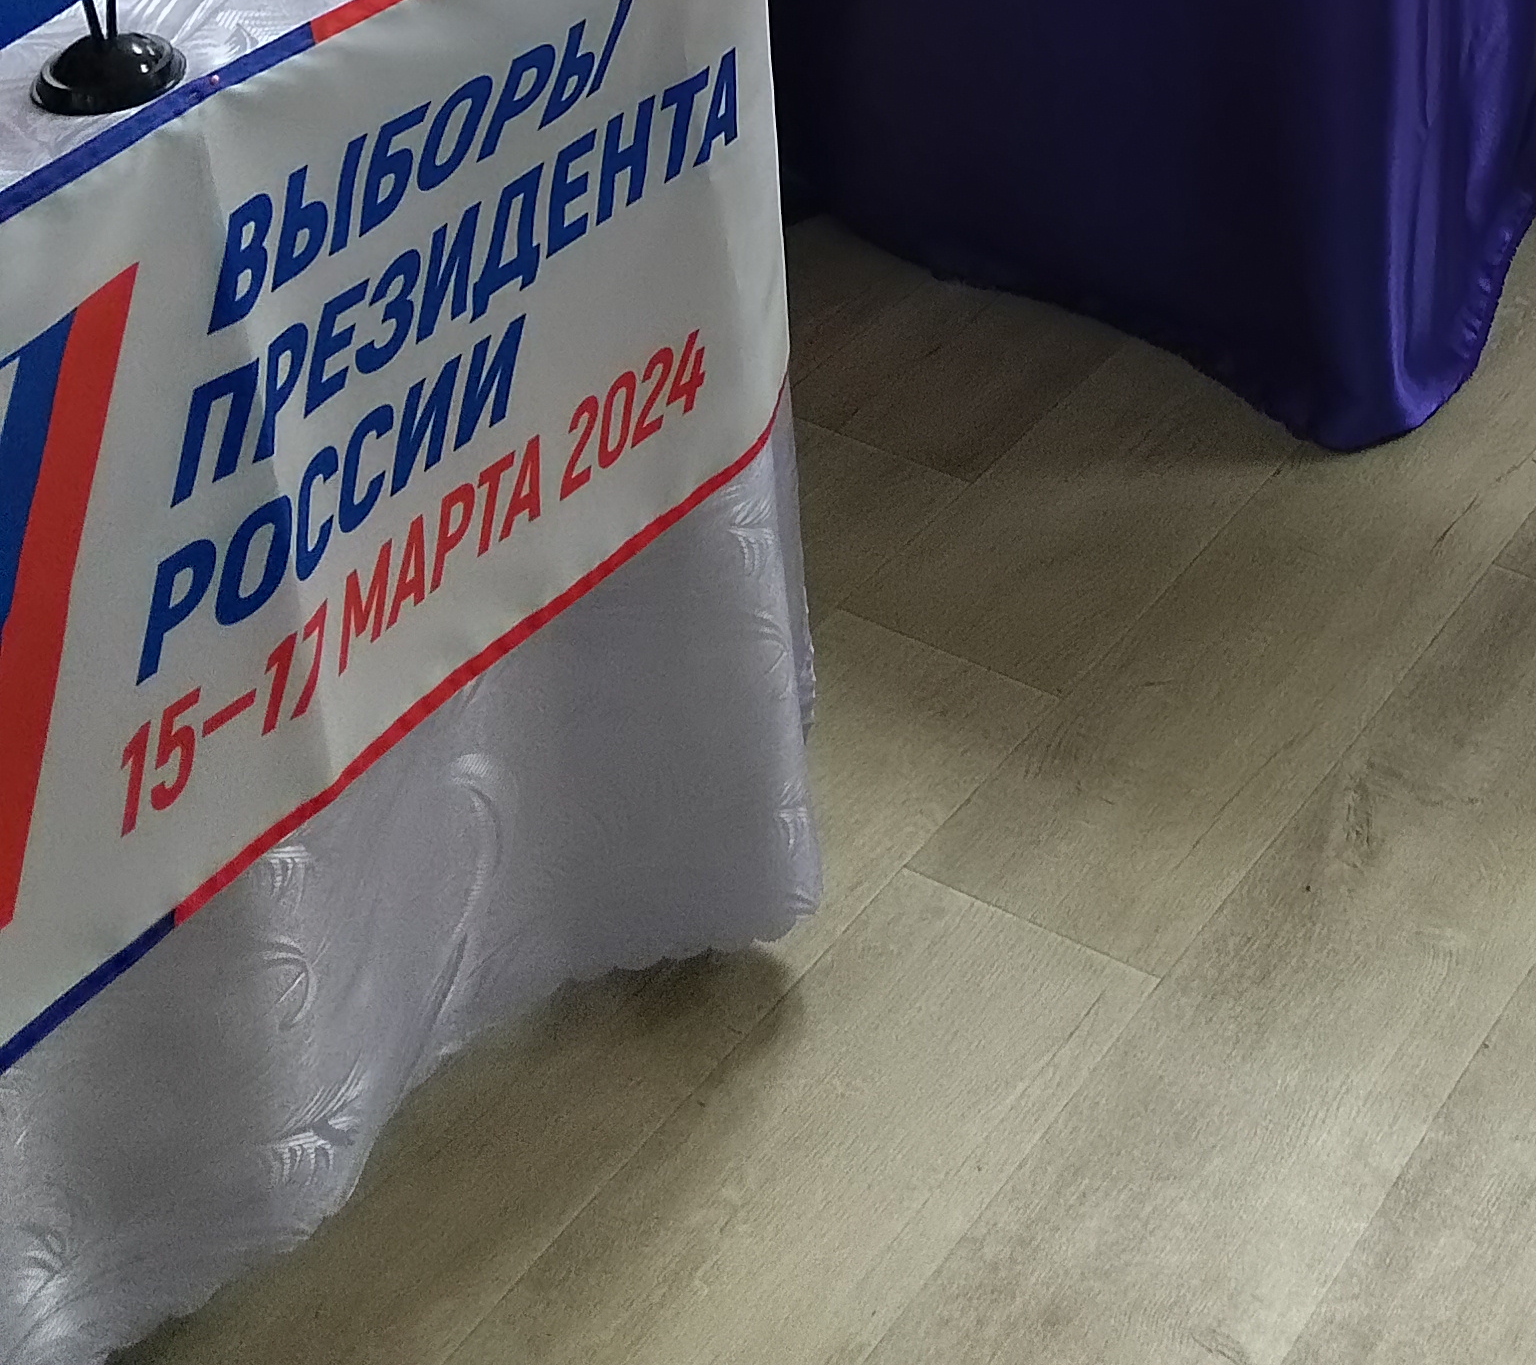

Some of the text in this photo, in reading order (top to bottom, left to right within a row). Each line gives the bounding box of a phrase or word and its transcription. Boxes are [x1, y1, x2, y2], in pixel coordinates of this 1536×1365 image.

[172, 50, 738, 505] ПРЕЗИДЕНТА
[137, 314, 525, 686] РОССИИ
[339, 437, 540, 672] МАРТА
[559, 331, 706, 501] 2024
